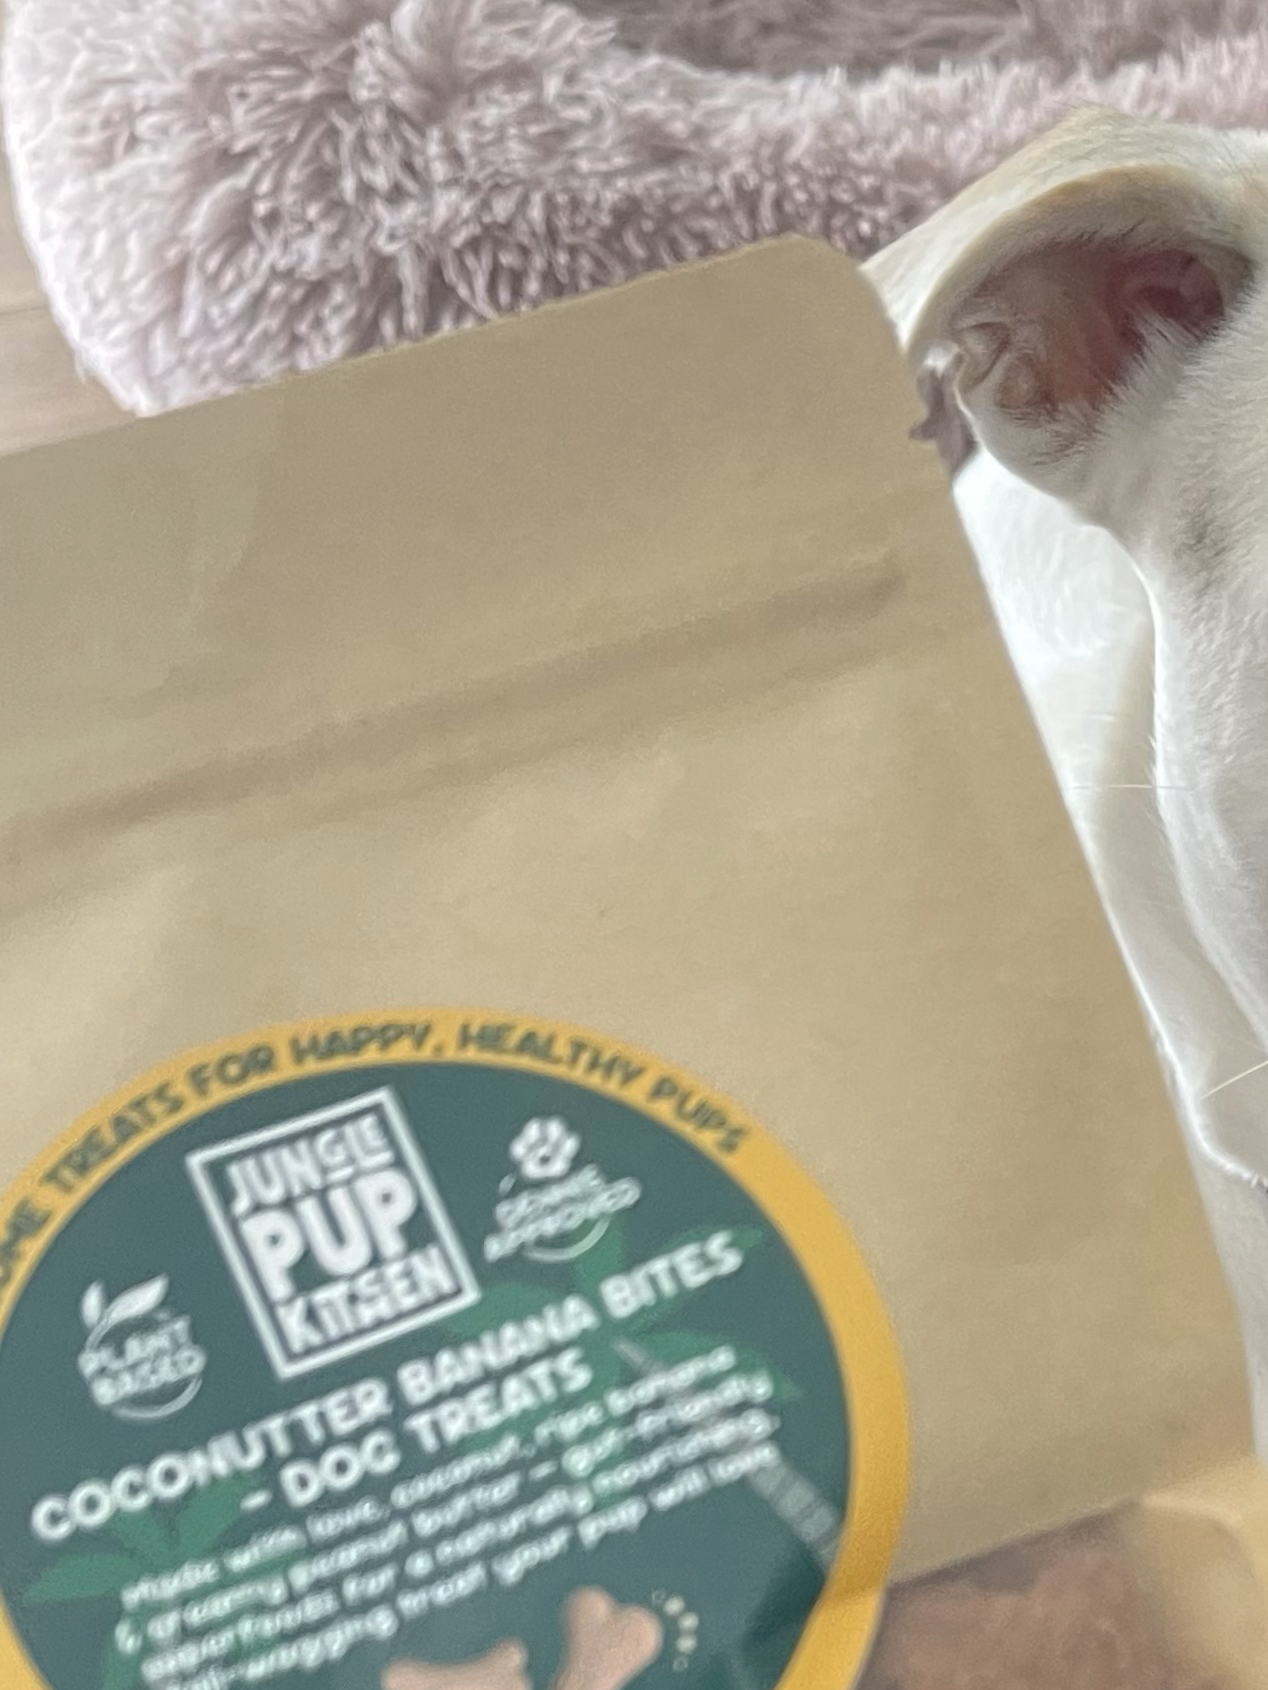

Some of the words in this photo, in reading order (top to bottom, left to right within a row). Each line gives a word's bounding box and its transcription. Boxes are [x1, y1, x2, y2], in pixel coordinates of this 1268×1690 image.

[40, 1081, 185, 1193] TREATS
[188, 1045, 276, 1097] FOR
[290, 1022, 445, 1066] HAPPY,
[459, 1022, 647, 1088] HEALTHY
[648, 1076, 746, 1155] PUPS
[226, 1113, 394, 1216] JUNGLE
[242, 1167, 418, 1300] PUP
[33, 1380, 388, 1538] COCONUTTER
[398, 1297, 595, 1403] BANANA
[601, 1233, 740, 1317] BITES
[281, 1431, 398, 1505] DOG
[406, 1349, 590, 1450] TREATS
[605, 1347, 733, 1414] banana
[578, 1498, 646, 1545] pup
